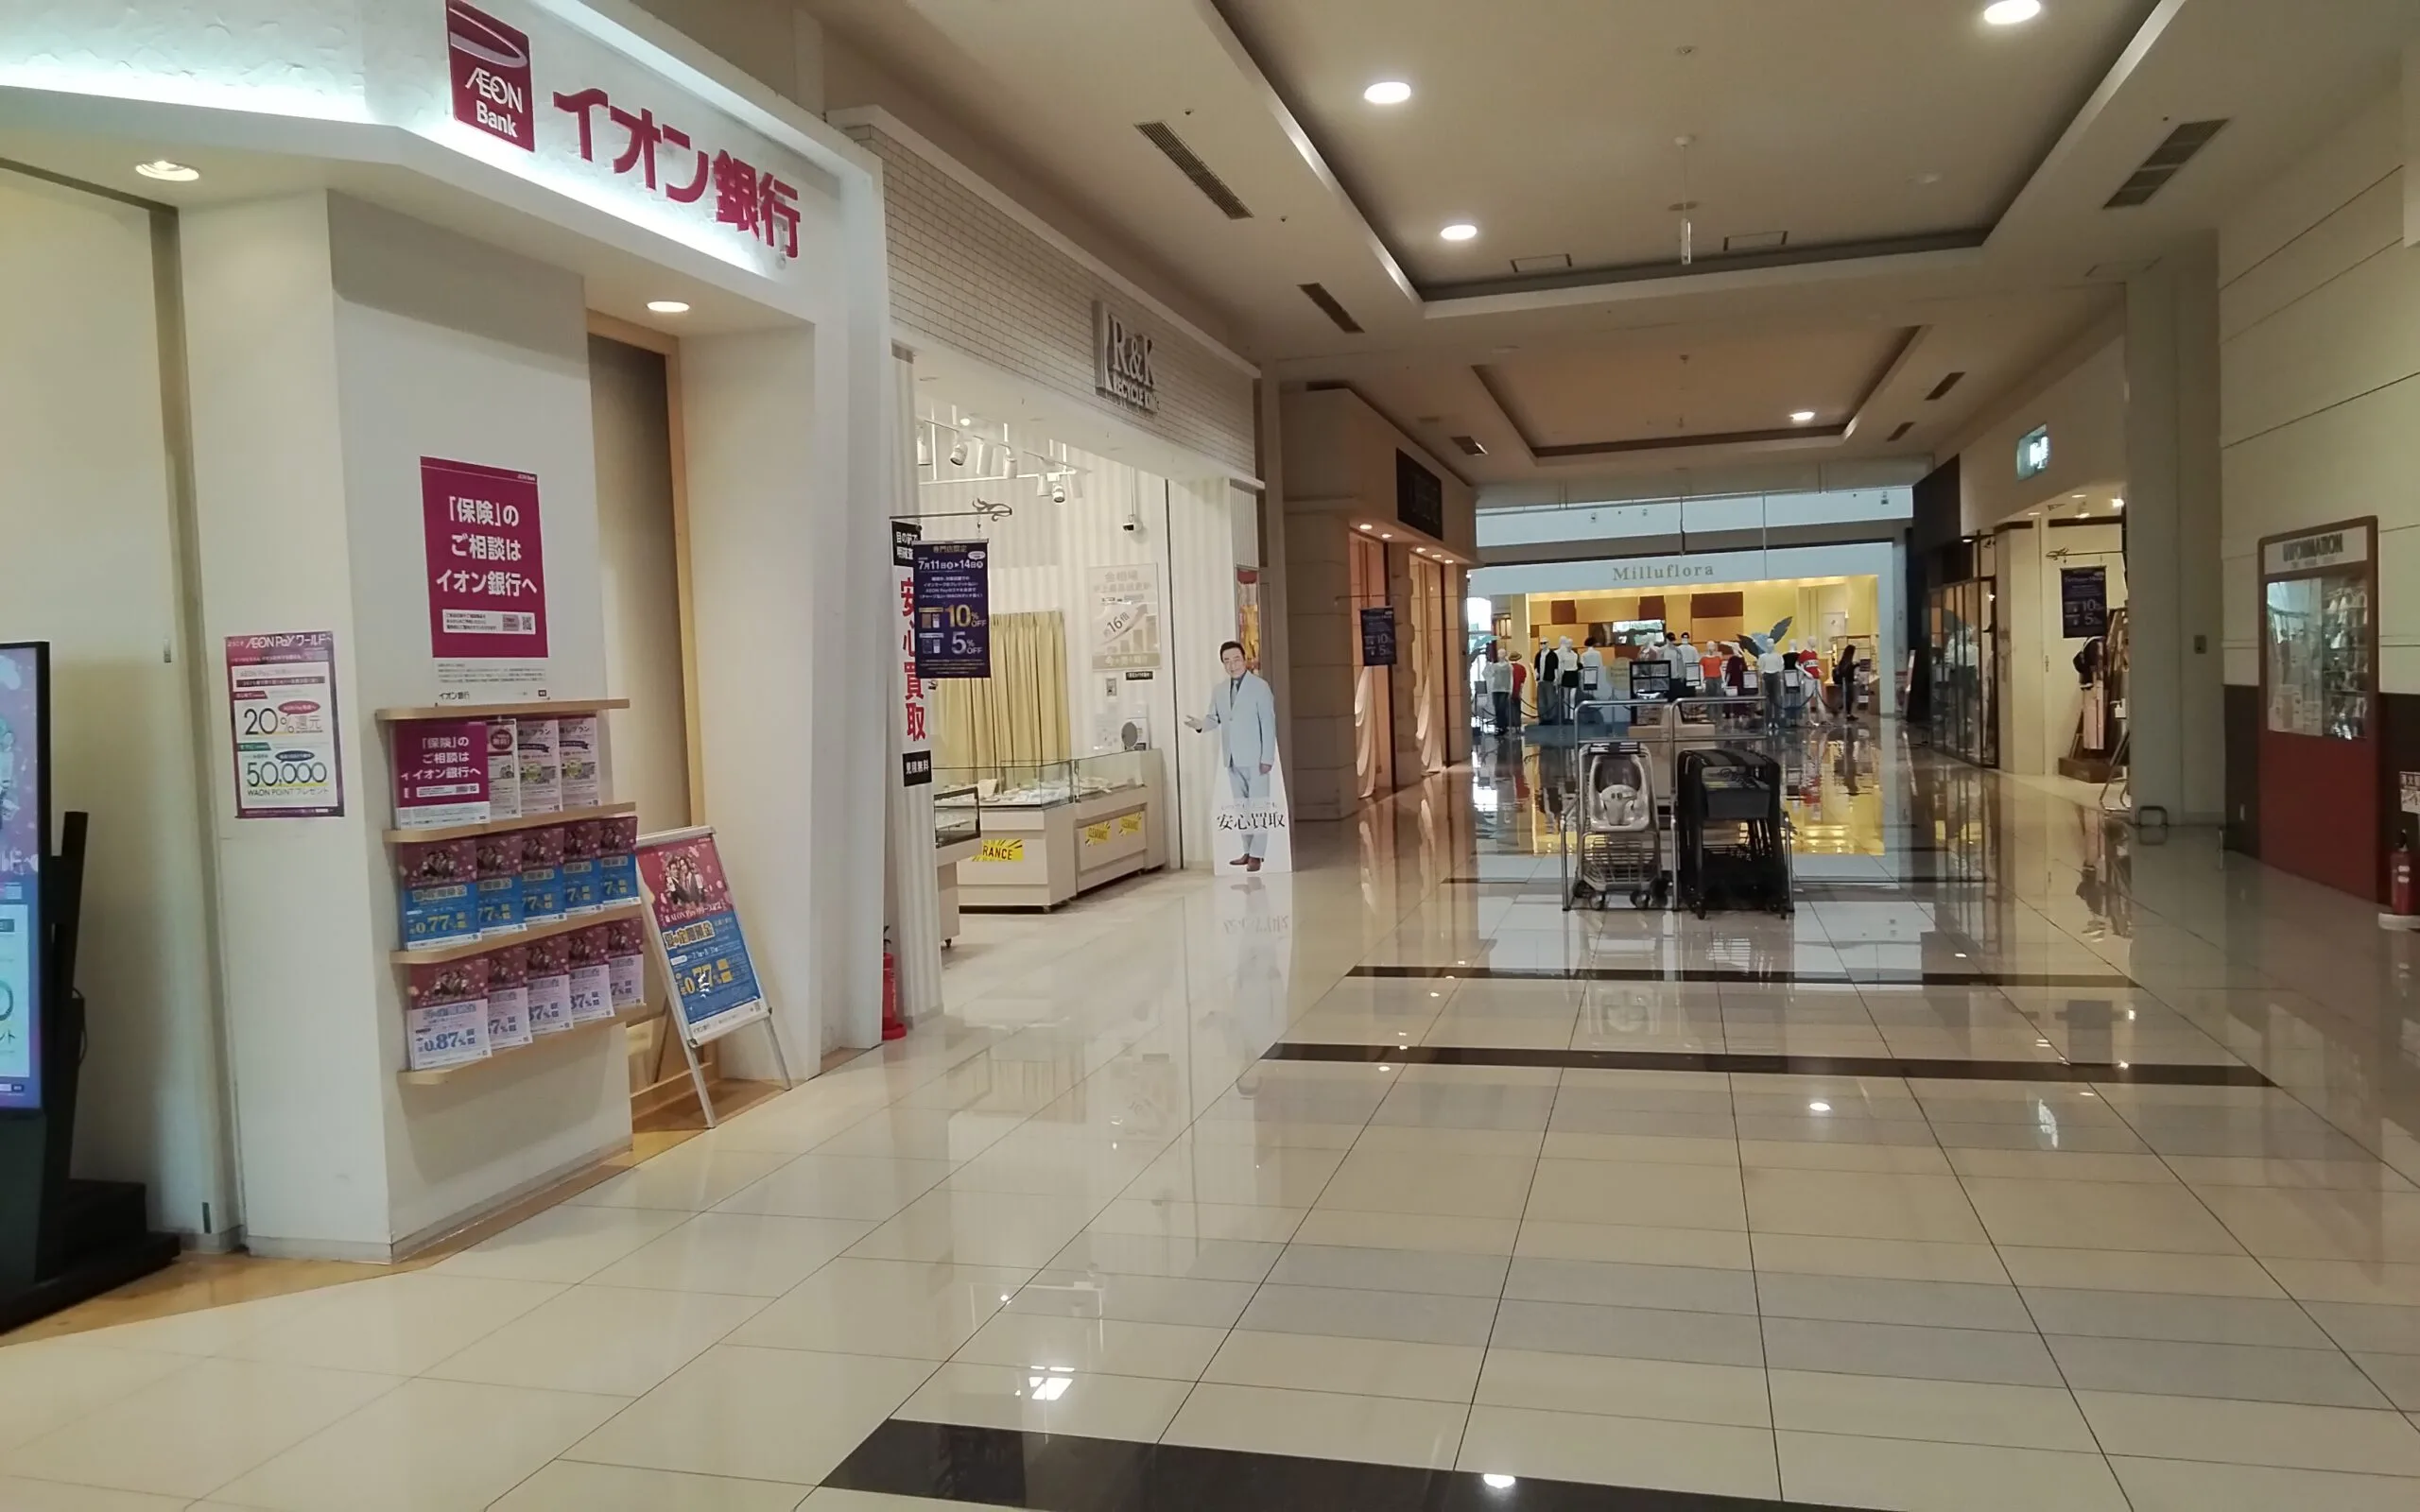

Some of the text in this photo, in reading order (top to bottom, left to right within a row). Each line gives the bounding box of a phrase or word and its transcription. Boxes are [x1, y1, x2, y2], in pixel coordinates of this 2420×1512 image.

[475, 100, 518, 138] Bank
[552, 88, 801, 259] イオン銀行
[1113, 314, 1154, 386] R&K
[448, 495, 519, 527] 「保険」の
[451, 533, 522, 561] ご相談は
[1613, 564, 1714, 581] Milluflora
[436, 568, 538, 597] イオン銀行へ
[971, 619, 987, 627] OFF
[966, 646, 983, 655] OFF
[423, 752, 470, 764] ご相談は
[412, 767, 481, 780] イオン銀行へ
[1217, 812, 1286, 831] 安心買取
[983, 845, 1012, 860] RANCE
